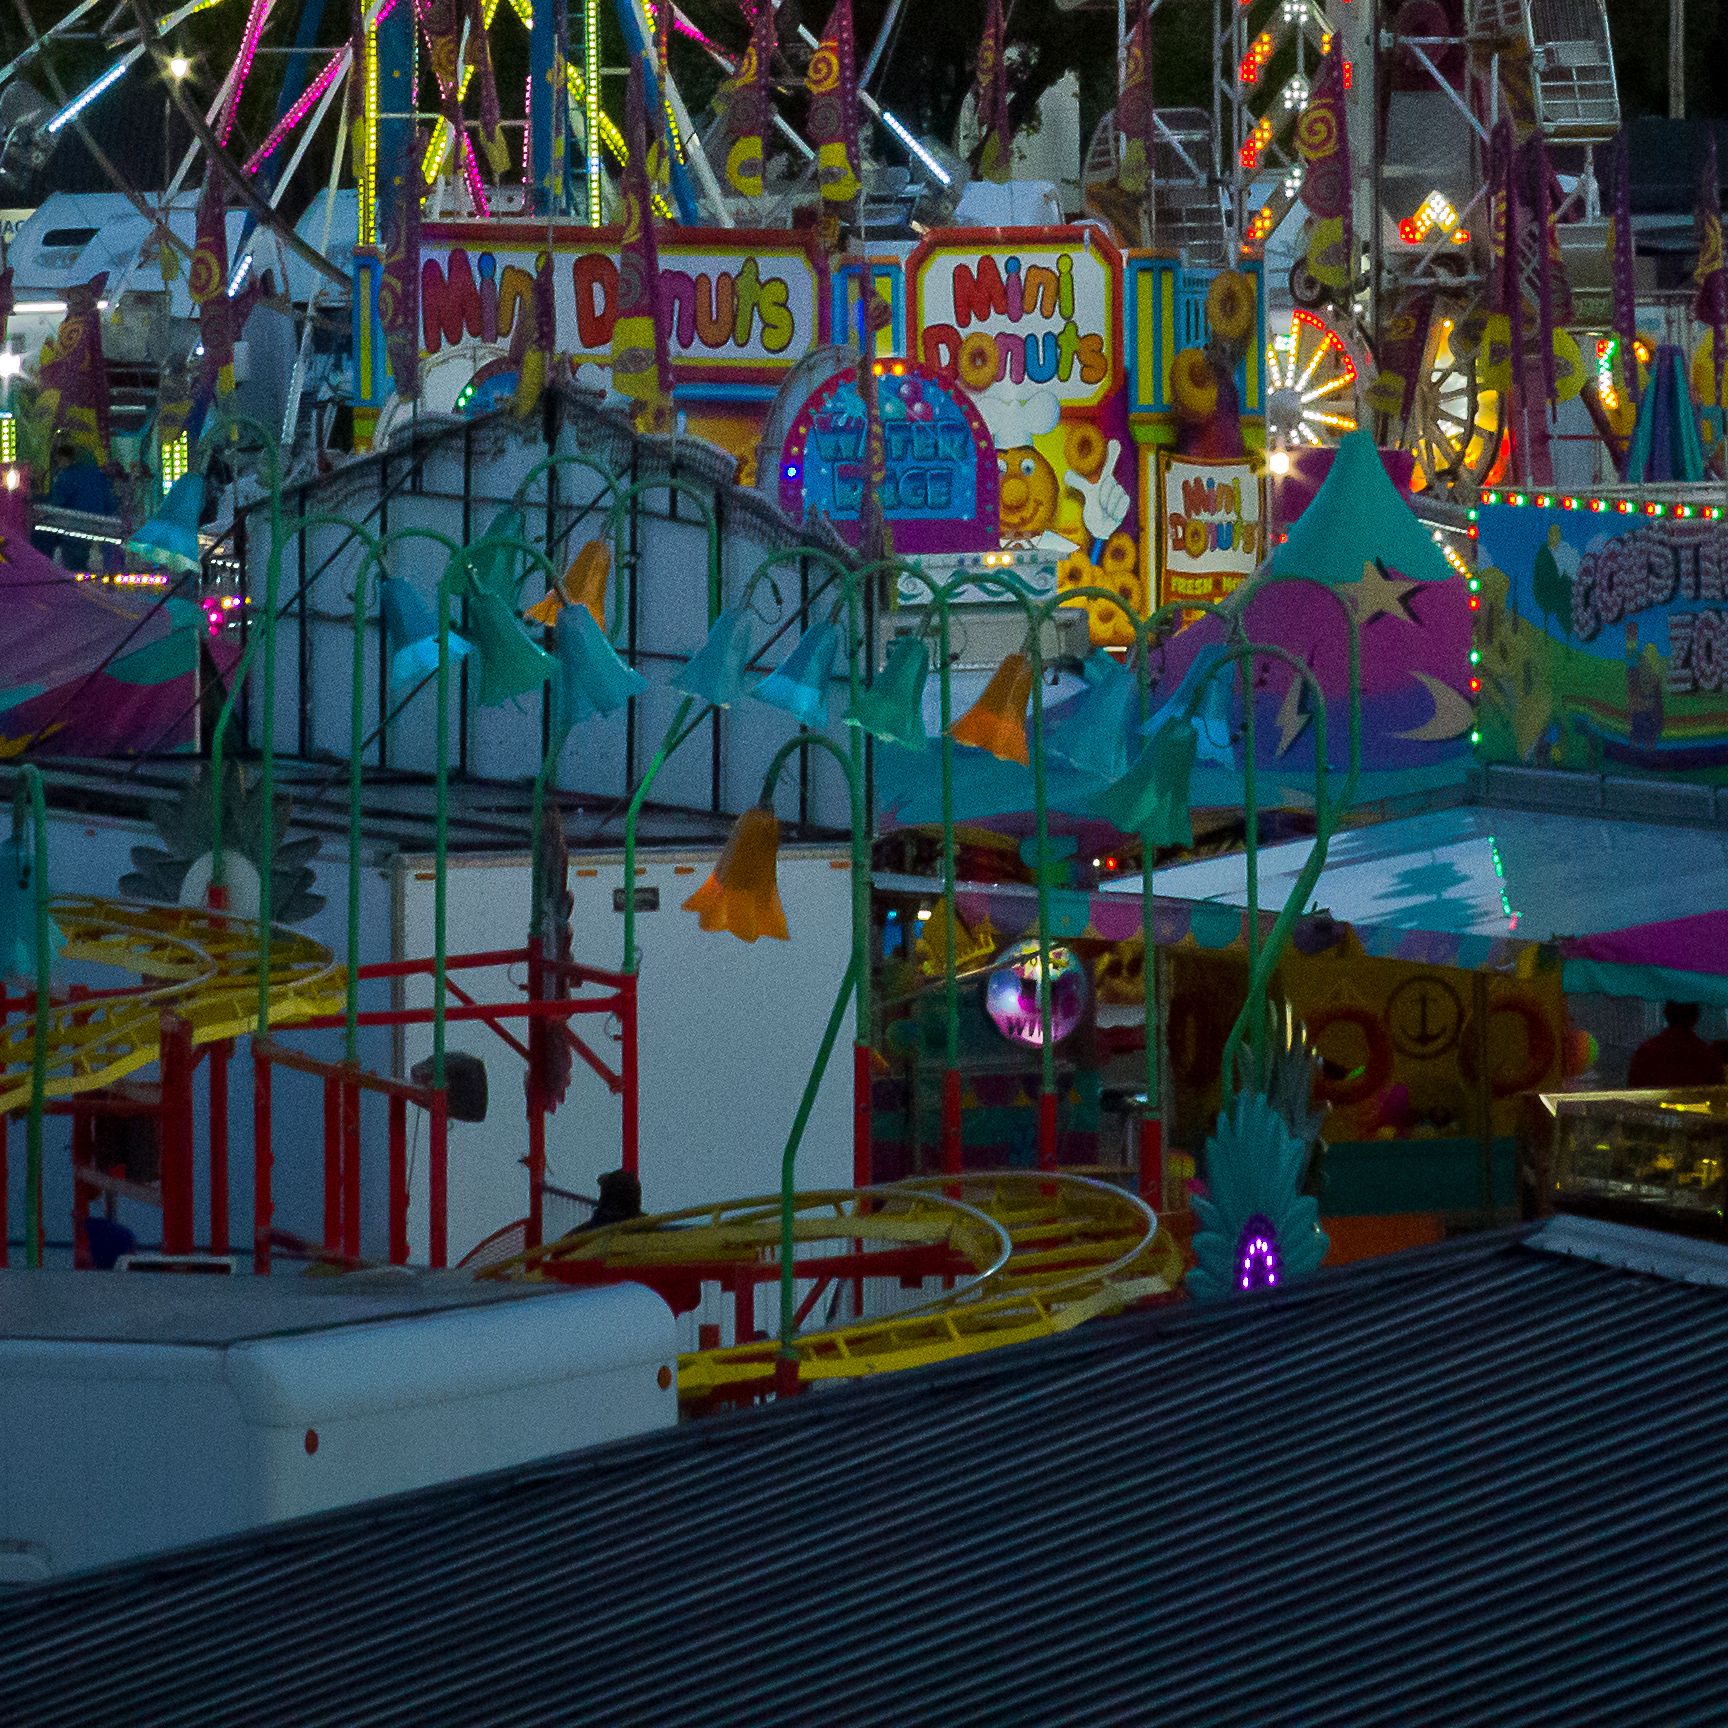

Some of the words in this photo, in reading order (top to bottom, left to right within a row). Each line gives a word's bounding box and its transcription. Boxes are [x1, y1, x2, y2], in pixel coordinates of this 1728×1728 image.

[421, 247, 552, 354] Min
[572, 253, 794, 354] Dnuts
[952, 253, 1075, 328] Mini
[922, 320, 1108, 393] Donuts
[813, 417, 970, 462] WTER
[1182, 477, 1242, 519] Mini
[1169, 512, 1258, 559] Donuts
